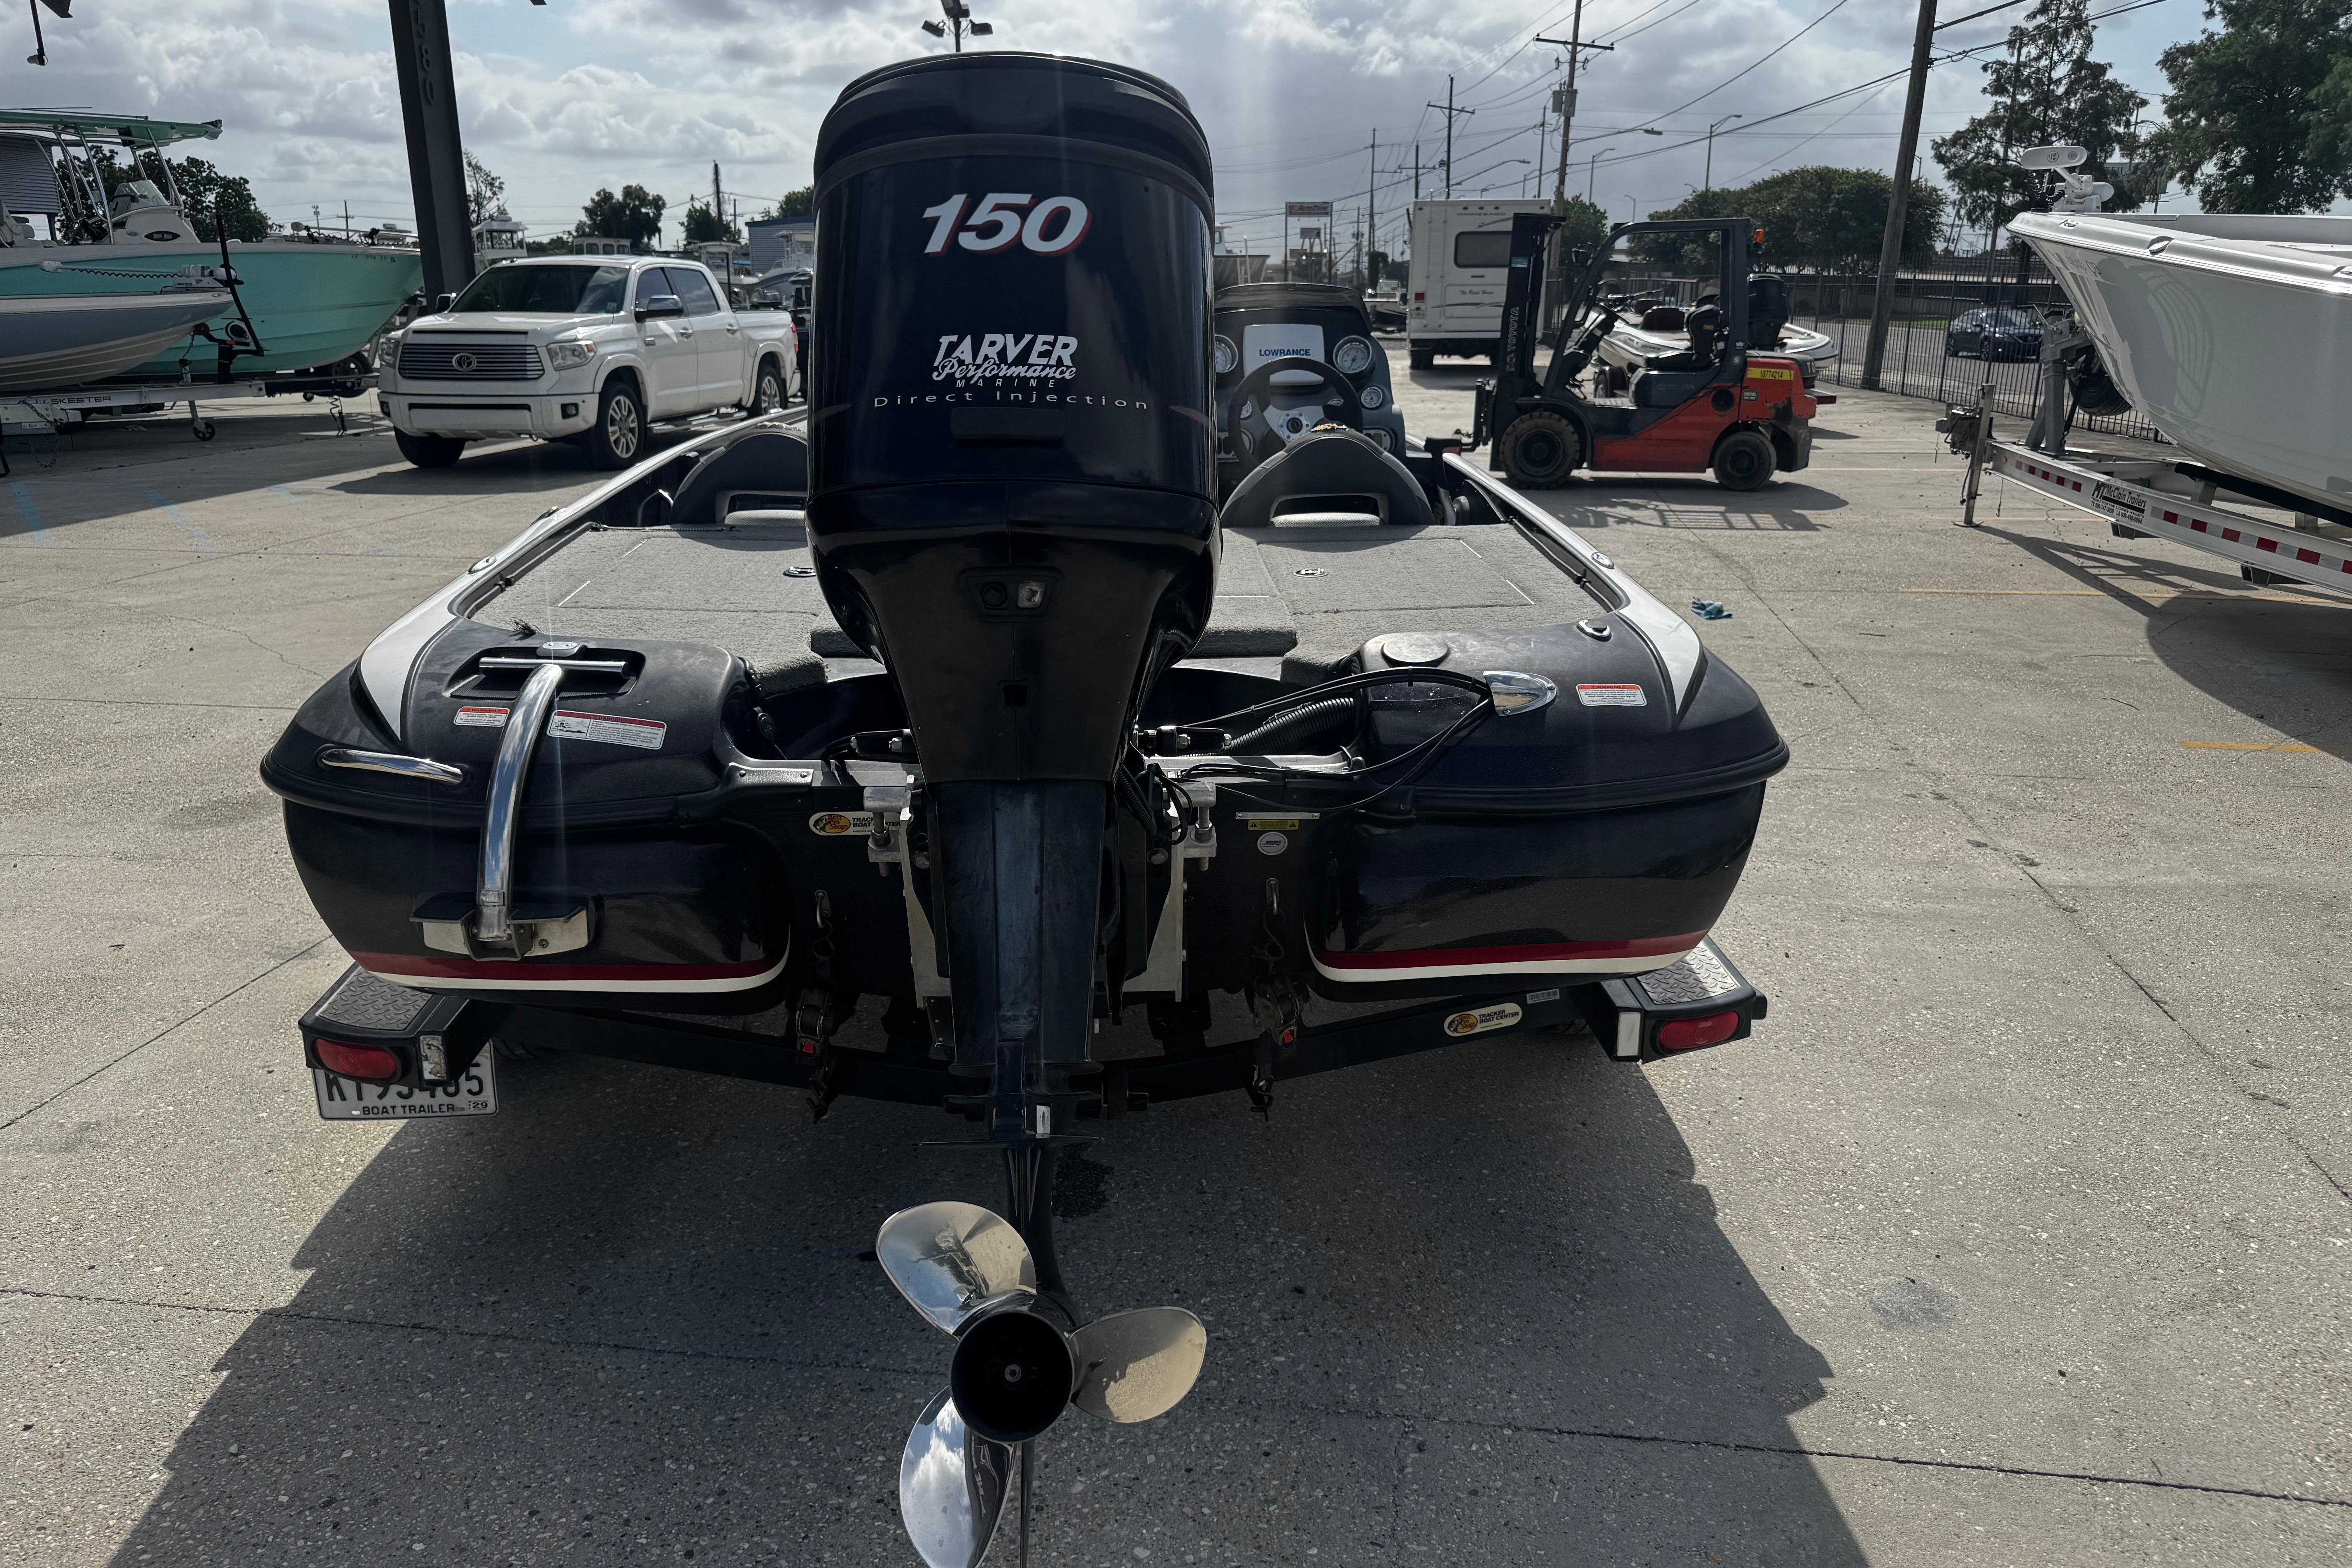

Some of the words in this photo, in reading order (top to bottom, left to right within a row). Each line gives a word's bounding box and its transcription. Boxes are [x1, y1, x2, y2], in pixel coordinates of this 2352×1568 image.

[922, 193, 1091, 256] 150
[1507, 307, 1519, 352] TOYOTA
[933, 333, 1078, 366] TARVER
[1259, 348, 1311, 357] LOWRANCE
[932, 357, 1076, 381] Performance
[1760, 370, 1783, 378] 10774214
[956, 379, 1055, 388] MARINE
[51, 396, 112, 404] SKEETER
[874, 392, 972, 407] Direct
[996, 391, 1147, 409] Injection
[2105, 485, 2126, 502] McClain
[2126, 491, 2147, 508] Trailers
[1479, 1010, 1505, 1019] TRACKER
[1496, 1011, 1519, 1020] CENTER
[362, 1105, 401, 1115] BOAT
[401, 1104, 455, 1114] TRAILER
